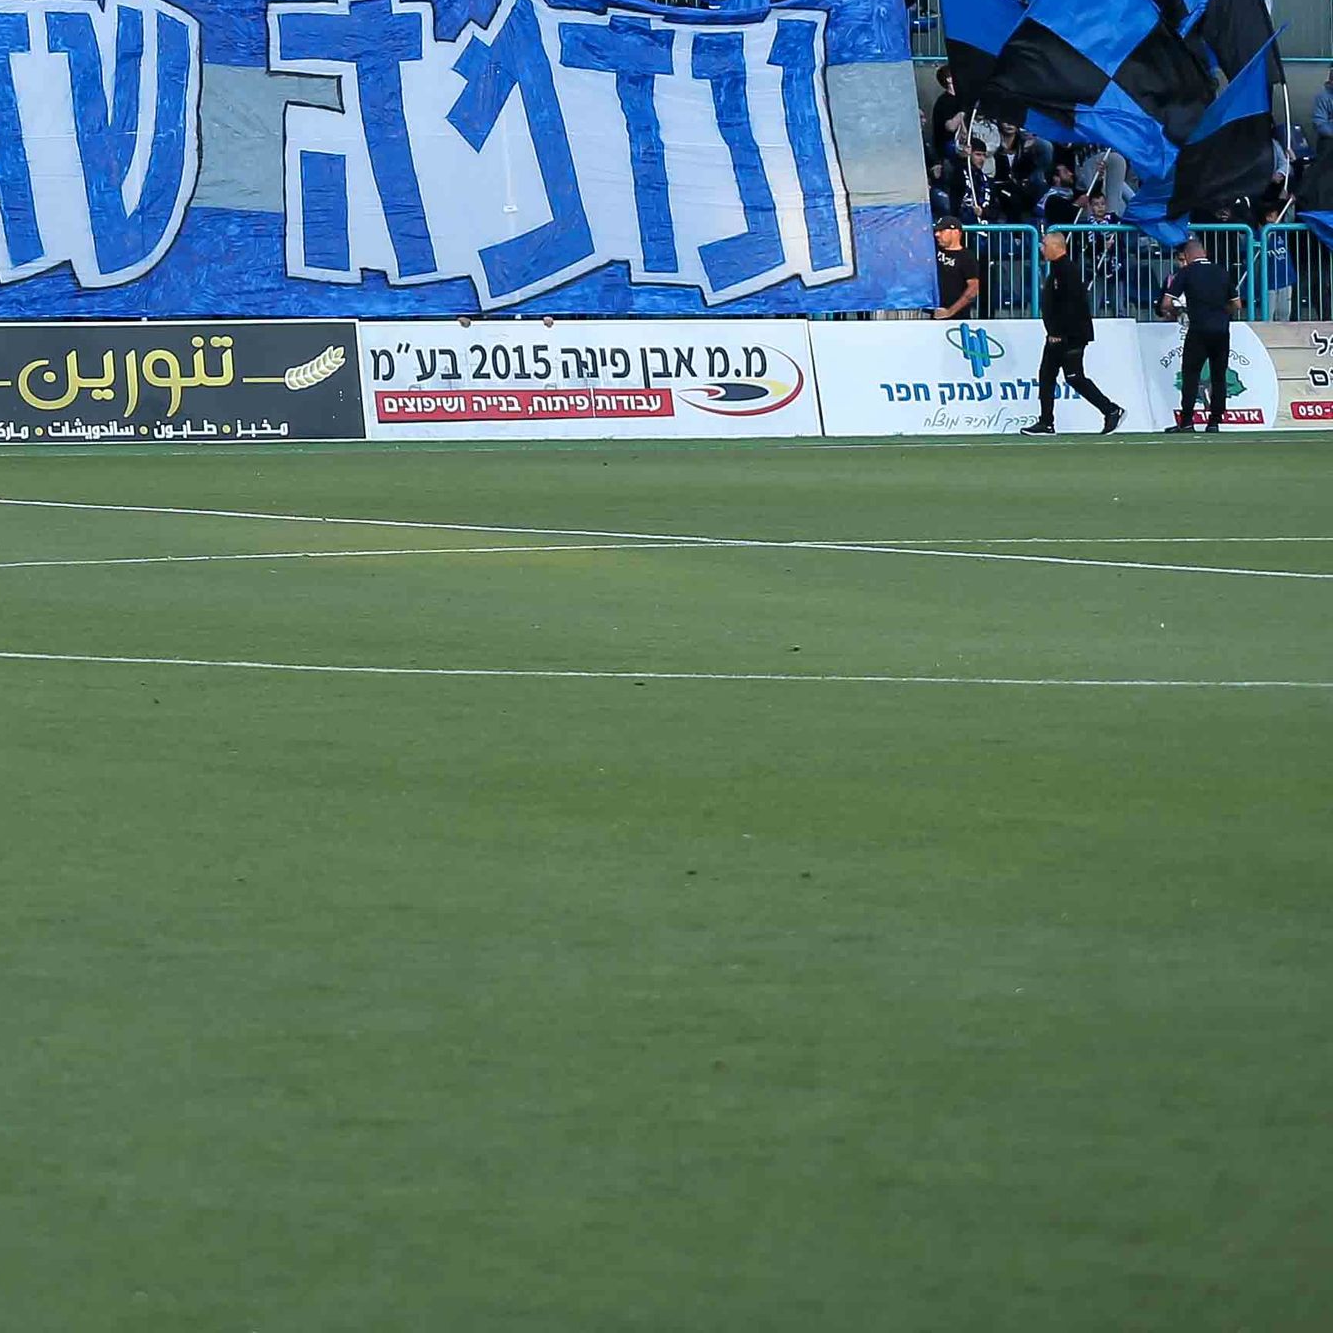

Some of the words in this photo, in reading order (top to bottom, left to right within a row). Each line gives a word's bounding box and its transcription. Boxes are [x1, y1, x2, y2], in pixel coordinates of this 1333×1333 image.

[469, 344, 552, 380] 2015
[560, 347, 631, 379] פינה
[640, 345, 695, 388] אבן
[709, 345, 768, 379] מ.מ
[18, 335, 234, 418] تنورين
[880, 382, 931, 401] חפר
[938, 382, 993, 405] עמק
[383, 396, 466, 413] ושיפוצים
[472, 396, 521, 412] בנייה
[527, 395, 590, 414] פיתוח,
[595, 395, 661, 412] עבודות
[1227, 410, 1259, 422] אדיב
[236, 419, 288, 437] مخبز
